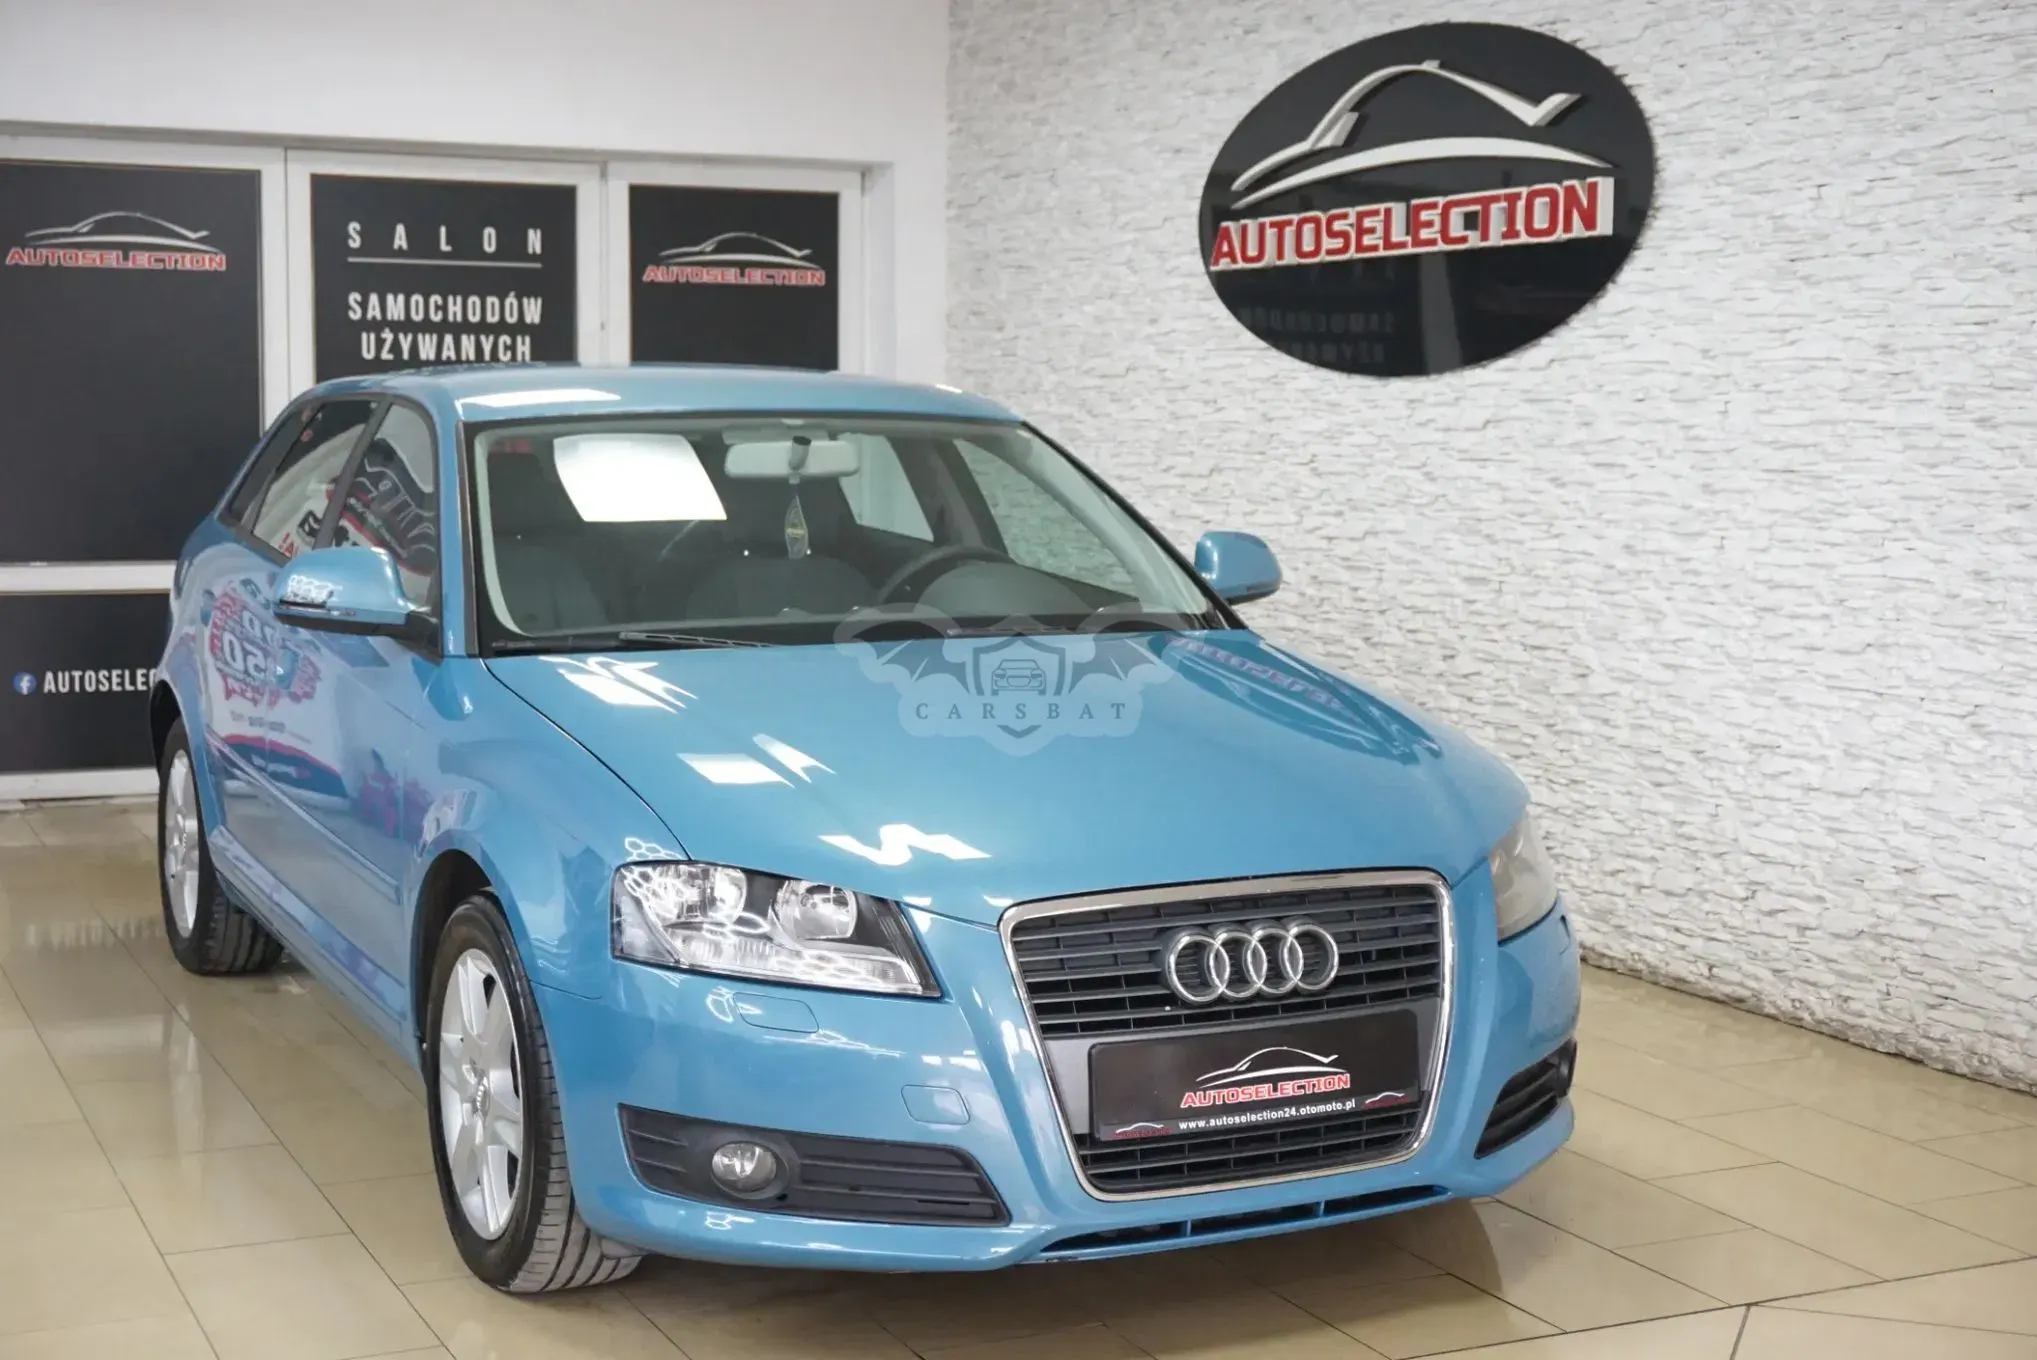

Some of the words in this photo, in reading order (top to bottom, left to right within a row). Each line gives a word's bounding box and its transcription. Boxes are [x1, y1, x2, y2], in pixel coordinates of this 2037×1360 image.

[1210, 177, 1614, 271] AUTOSELECTION
[5, 246, 226, 271] AUTOSELECTION
[642, 264, 826, 286] AUTOSELECTION
[347, 291, 542, 324] SAMOCHODÓW
[360, 327, 531, 362] UŻYWANYCH
[1180, 1073, 1350, 1108] AUTOSELECTION
[1179, 1099, 1356, 1130] www.autoselection24.otomoto.pl
